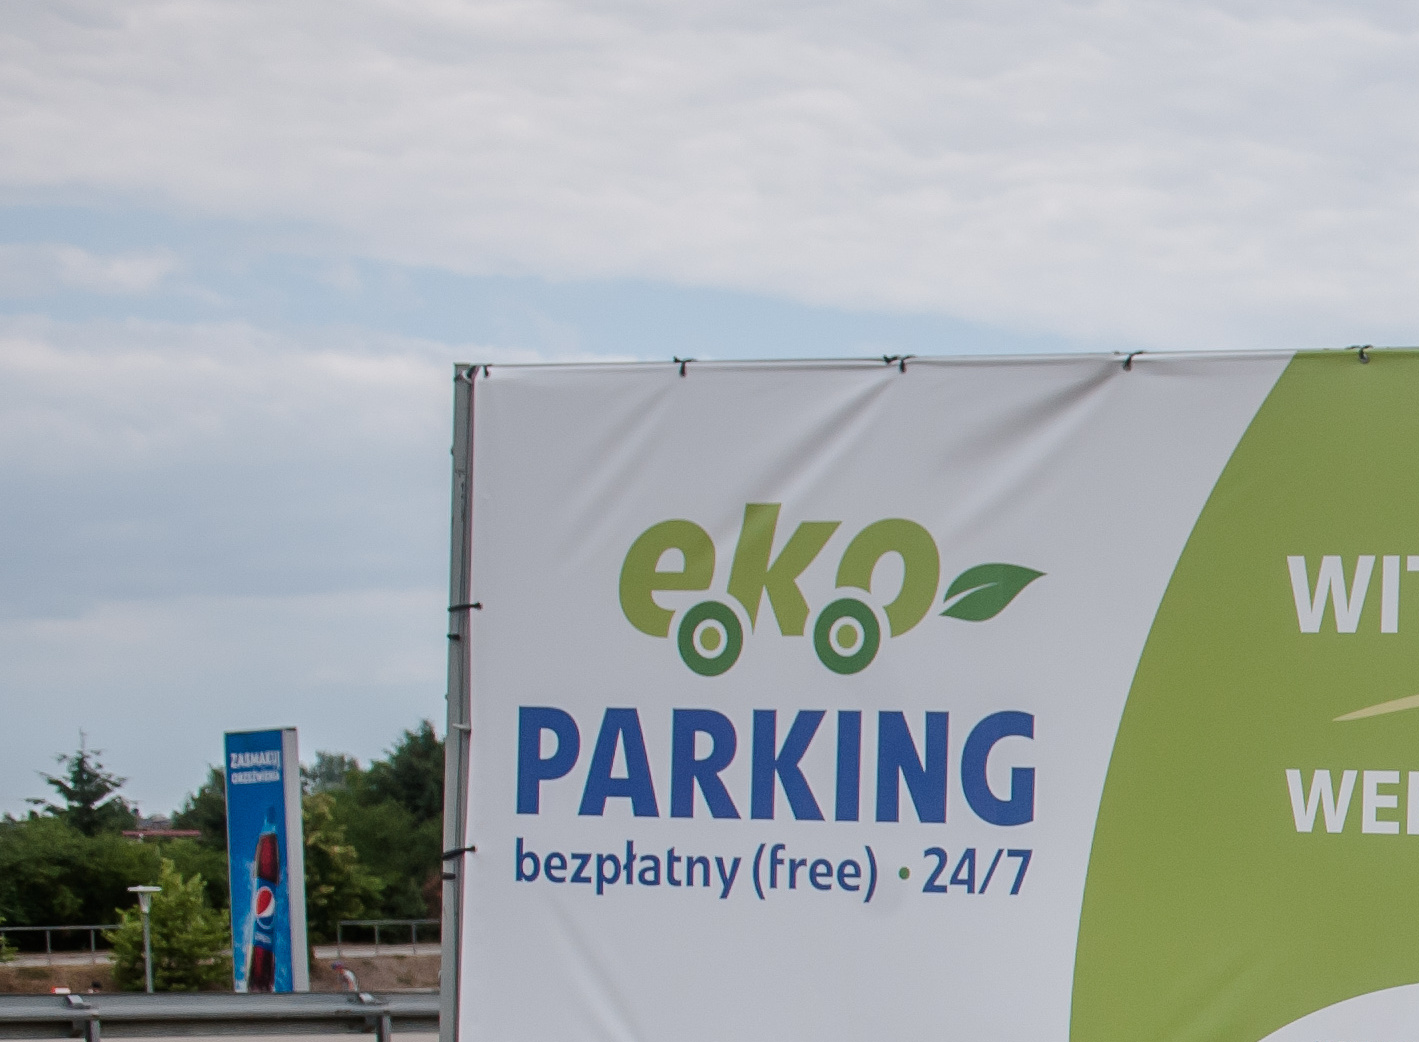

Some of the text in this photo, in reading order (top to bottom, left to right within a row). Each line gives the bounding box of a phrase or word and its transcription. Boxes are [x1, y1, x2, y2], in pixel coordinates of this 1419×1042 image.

[619, 503, 941, 639] eko
[516, 706, 1035, 827] PARKING
[515, 838, 1034, 903] bezpłatny (free) 24/7
